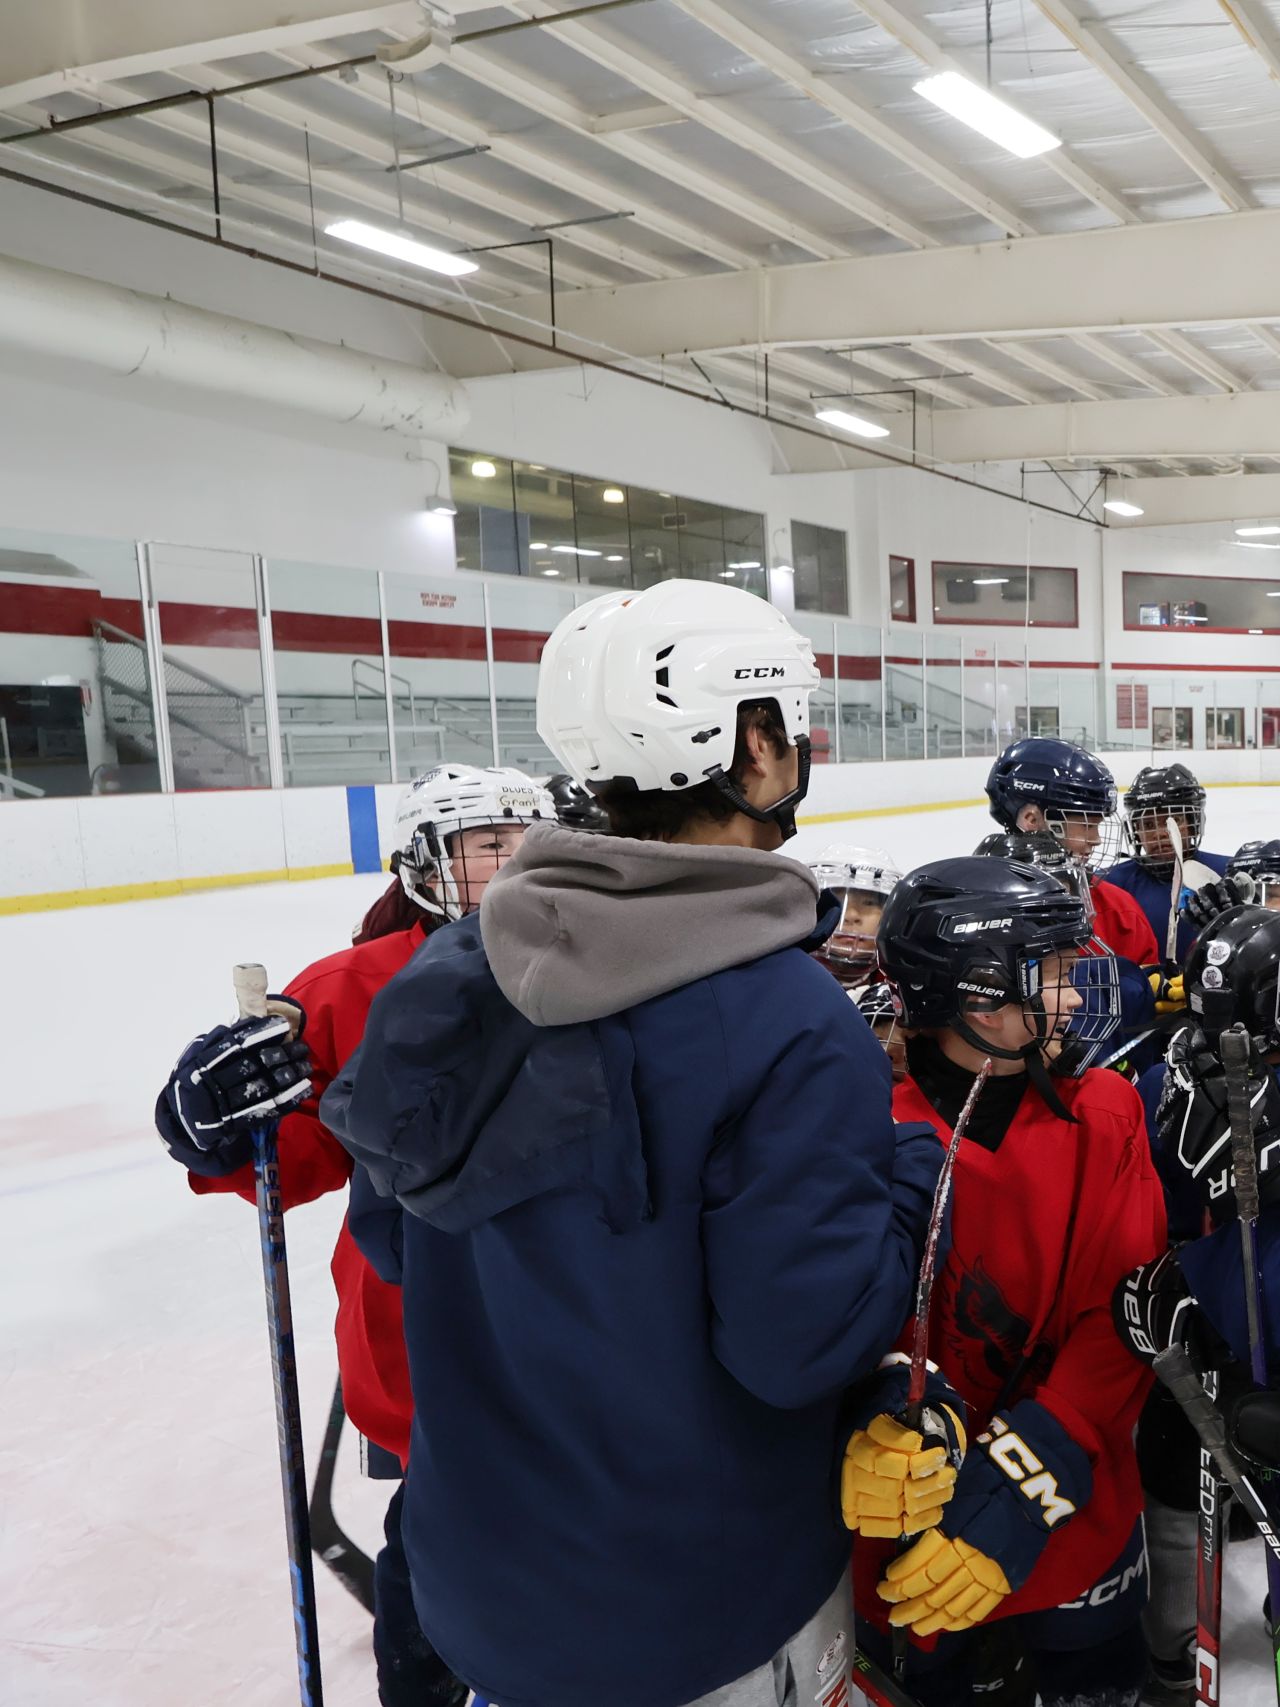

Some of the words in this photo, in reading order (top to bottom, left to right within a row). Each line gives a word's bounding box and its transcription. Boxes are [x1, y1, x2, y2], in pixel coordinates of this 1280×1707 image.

[734, 667, 785, 680] CCM
[1014, 781, 1045, 791] CCM
[499, 796, 537, 807] Grant
[1137, 792, 1163, 800] BAUER
[953, 918, 1013, 934] BAUER
[956, 981, 1006, 998] BAUER
[264, 1162, 283, 1243] CCM
